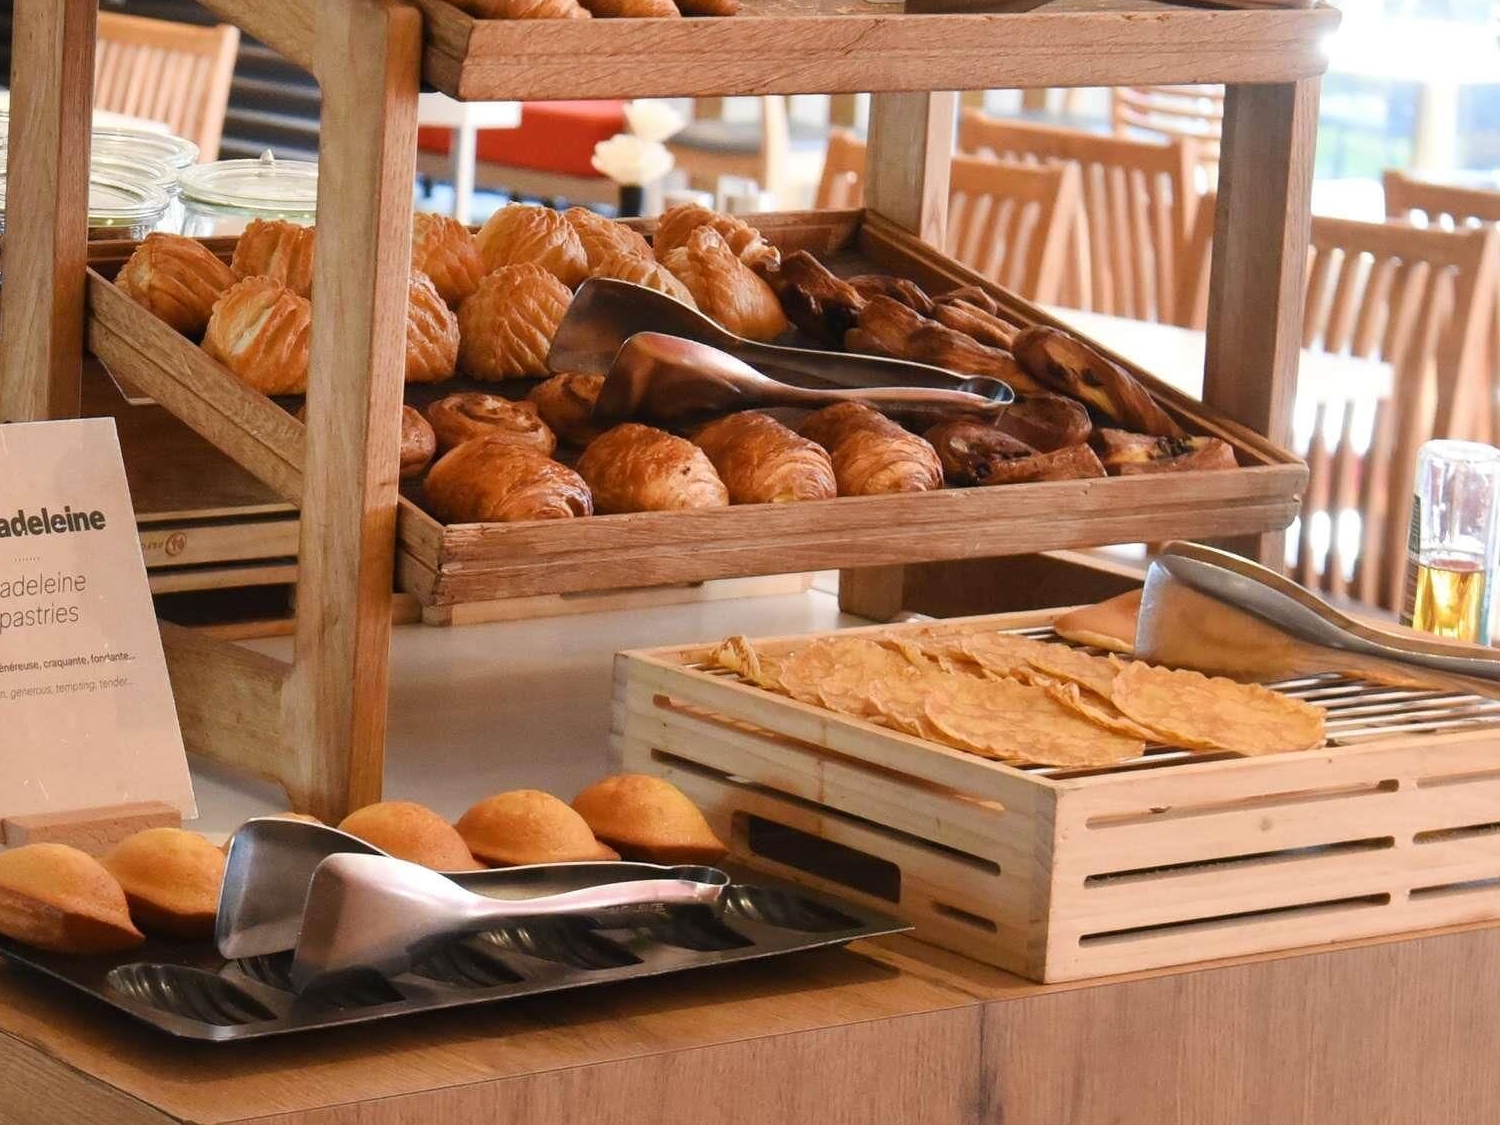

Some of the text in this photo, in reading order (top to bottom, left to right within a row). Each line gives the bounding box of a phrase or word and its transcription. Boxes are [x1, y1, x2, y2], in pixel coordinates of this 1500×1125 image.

[0, 603, 79, 635] pastries
[43, 656, 90, 671] craquante,
[55, 679, 98, 694] tempting,
